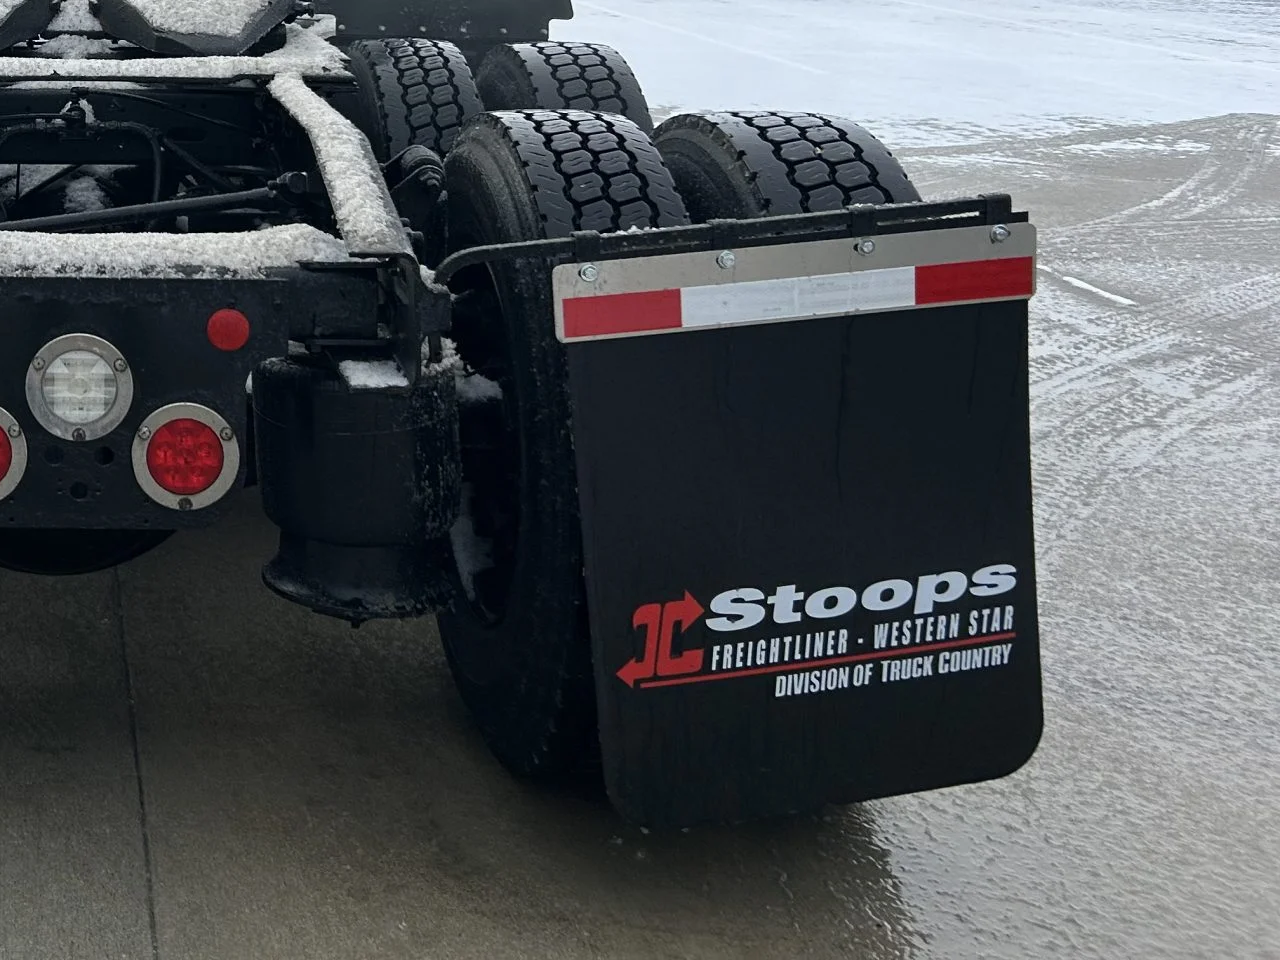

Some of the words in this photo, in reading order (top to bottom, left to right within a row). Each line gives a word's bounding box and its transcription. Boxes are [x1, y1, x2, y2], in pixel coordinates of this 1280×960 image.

[705, 563, 1017, 632] Stoops
[711, 628, 848, 671] FREIGHTLINER
[873, 612, 960, 650] WESTERN
[968, 605, 1014, 636] STAR
[774, 666, 850, 698] DIVISION
[852, 662, 874, 687] OF
[880, 654, 934, 683] TRUCK
[938, 643, 1013, 674] COUNTRY
